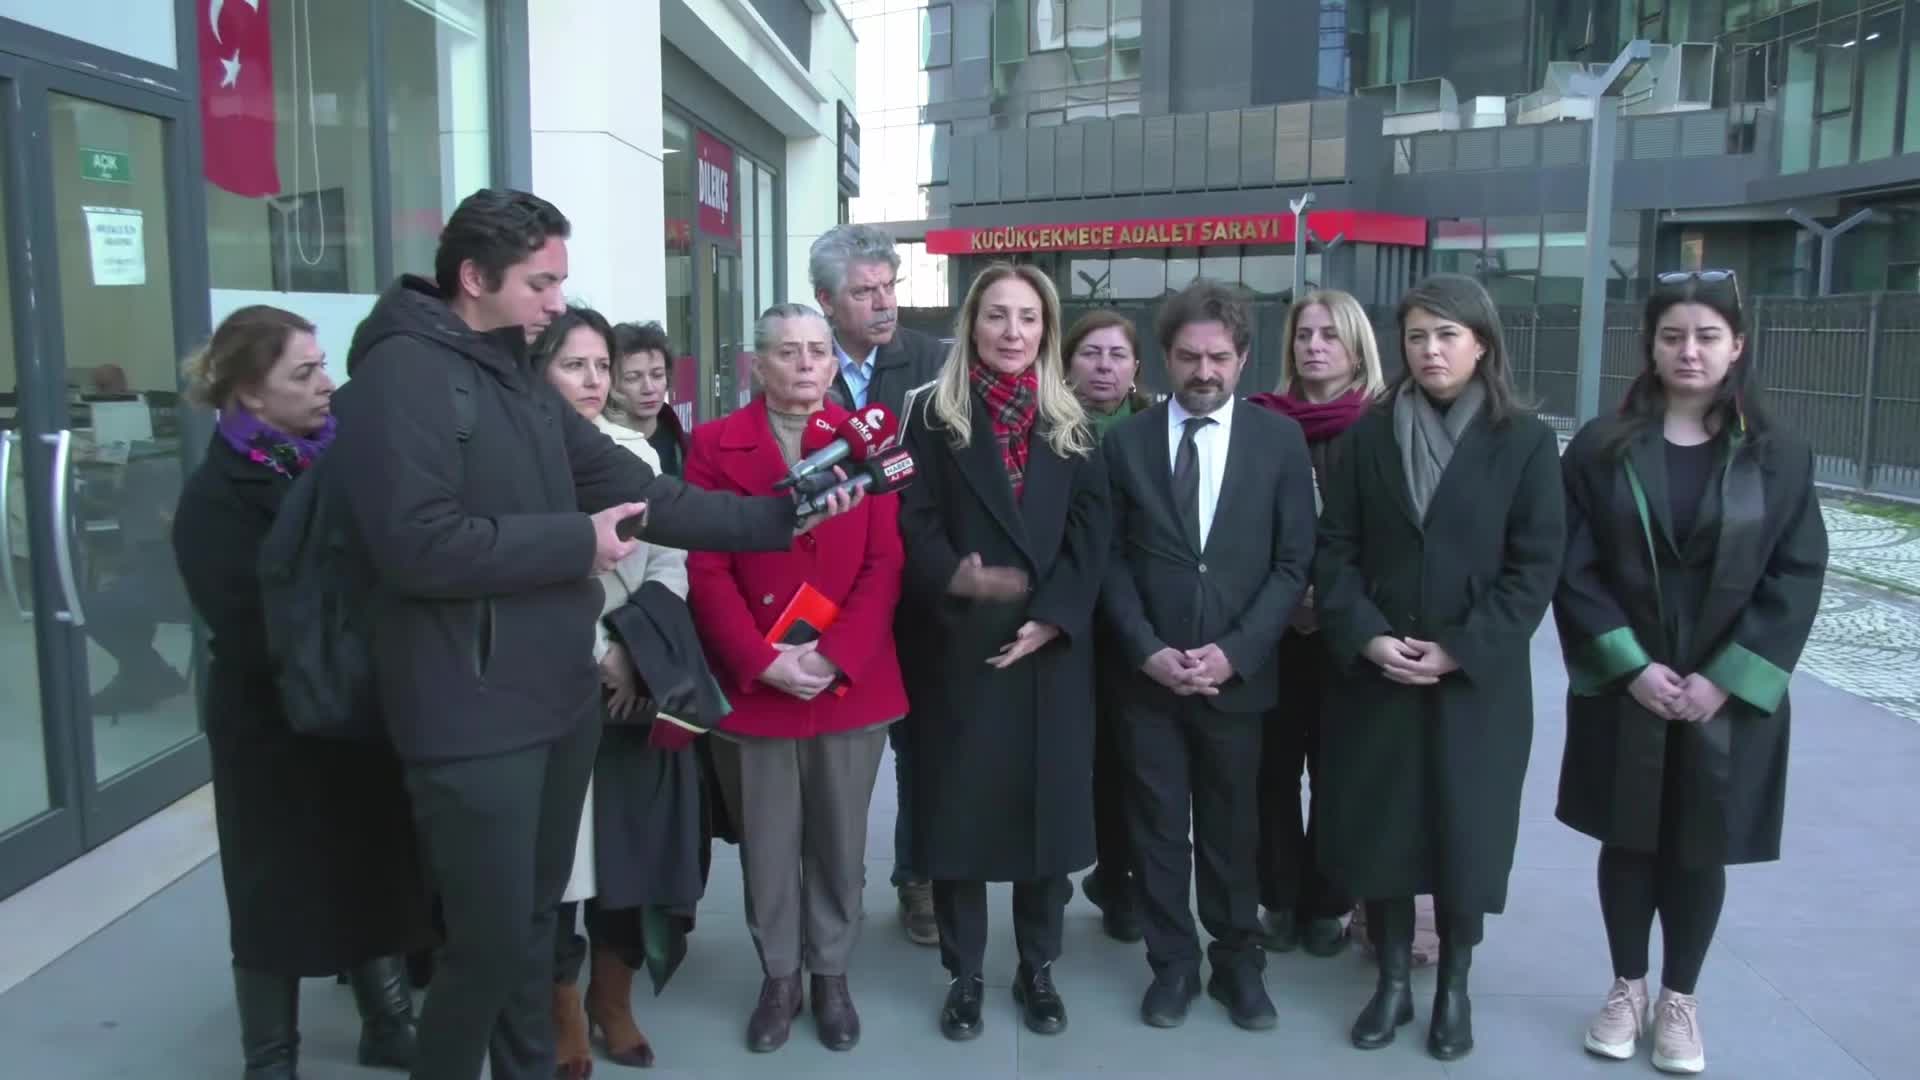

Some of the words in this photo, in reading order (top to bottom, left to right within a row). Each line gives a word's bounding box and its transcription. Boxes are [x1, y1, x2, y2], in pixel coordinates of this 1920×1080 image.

[1119, 222, 1195, 243] ADALET
[1201, 218, 1279, 240] SARAYI
[849, 416, 873, 441] anka
